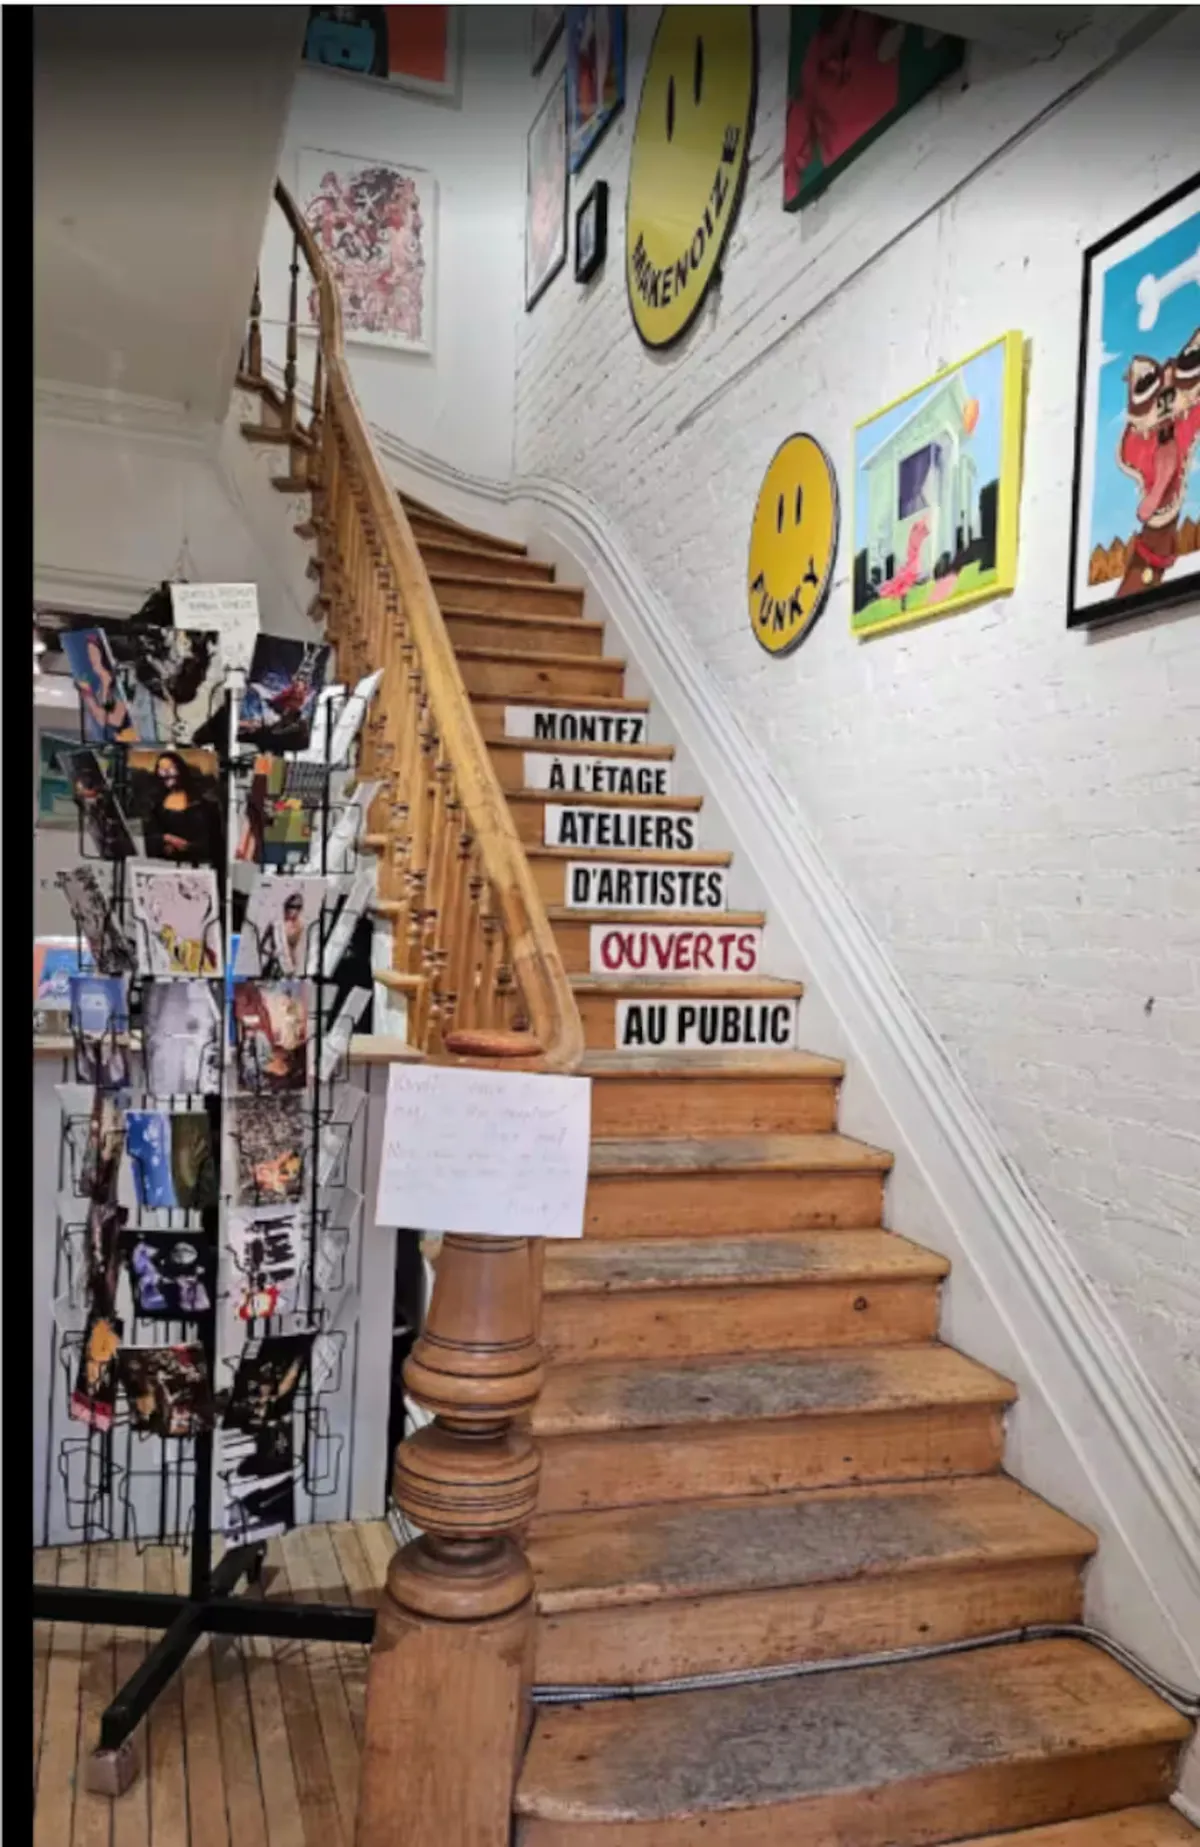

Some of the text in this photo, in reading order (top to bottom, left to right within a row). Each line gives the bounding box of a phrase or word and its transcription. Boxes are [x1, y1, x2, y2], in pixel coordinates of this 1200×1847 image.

[534, 712, 644, 744] MONTEZ
[549, 758, 667, 795] À L'ÉTAGE
[558, 811, 694, 850] ATELIERS
[572, 868, 722, 907] D'ARTISTES
[600, 931, 757, 971] OUVERTS
[622, 1006, 791, 1045] AU PUBLIC
